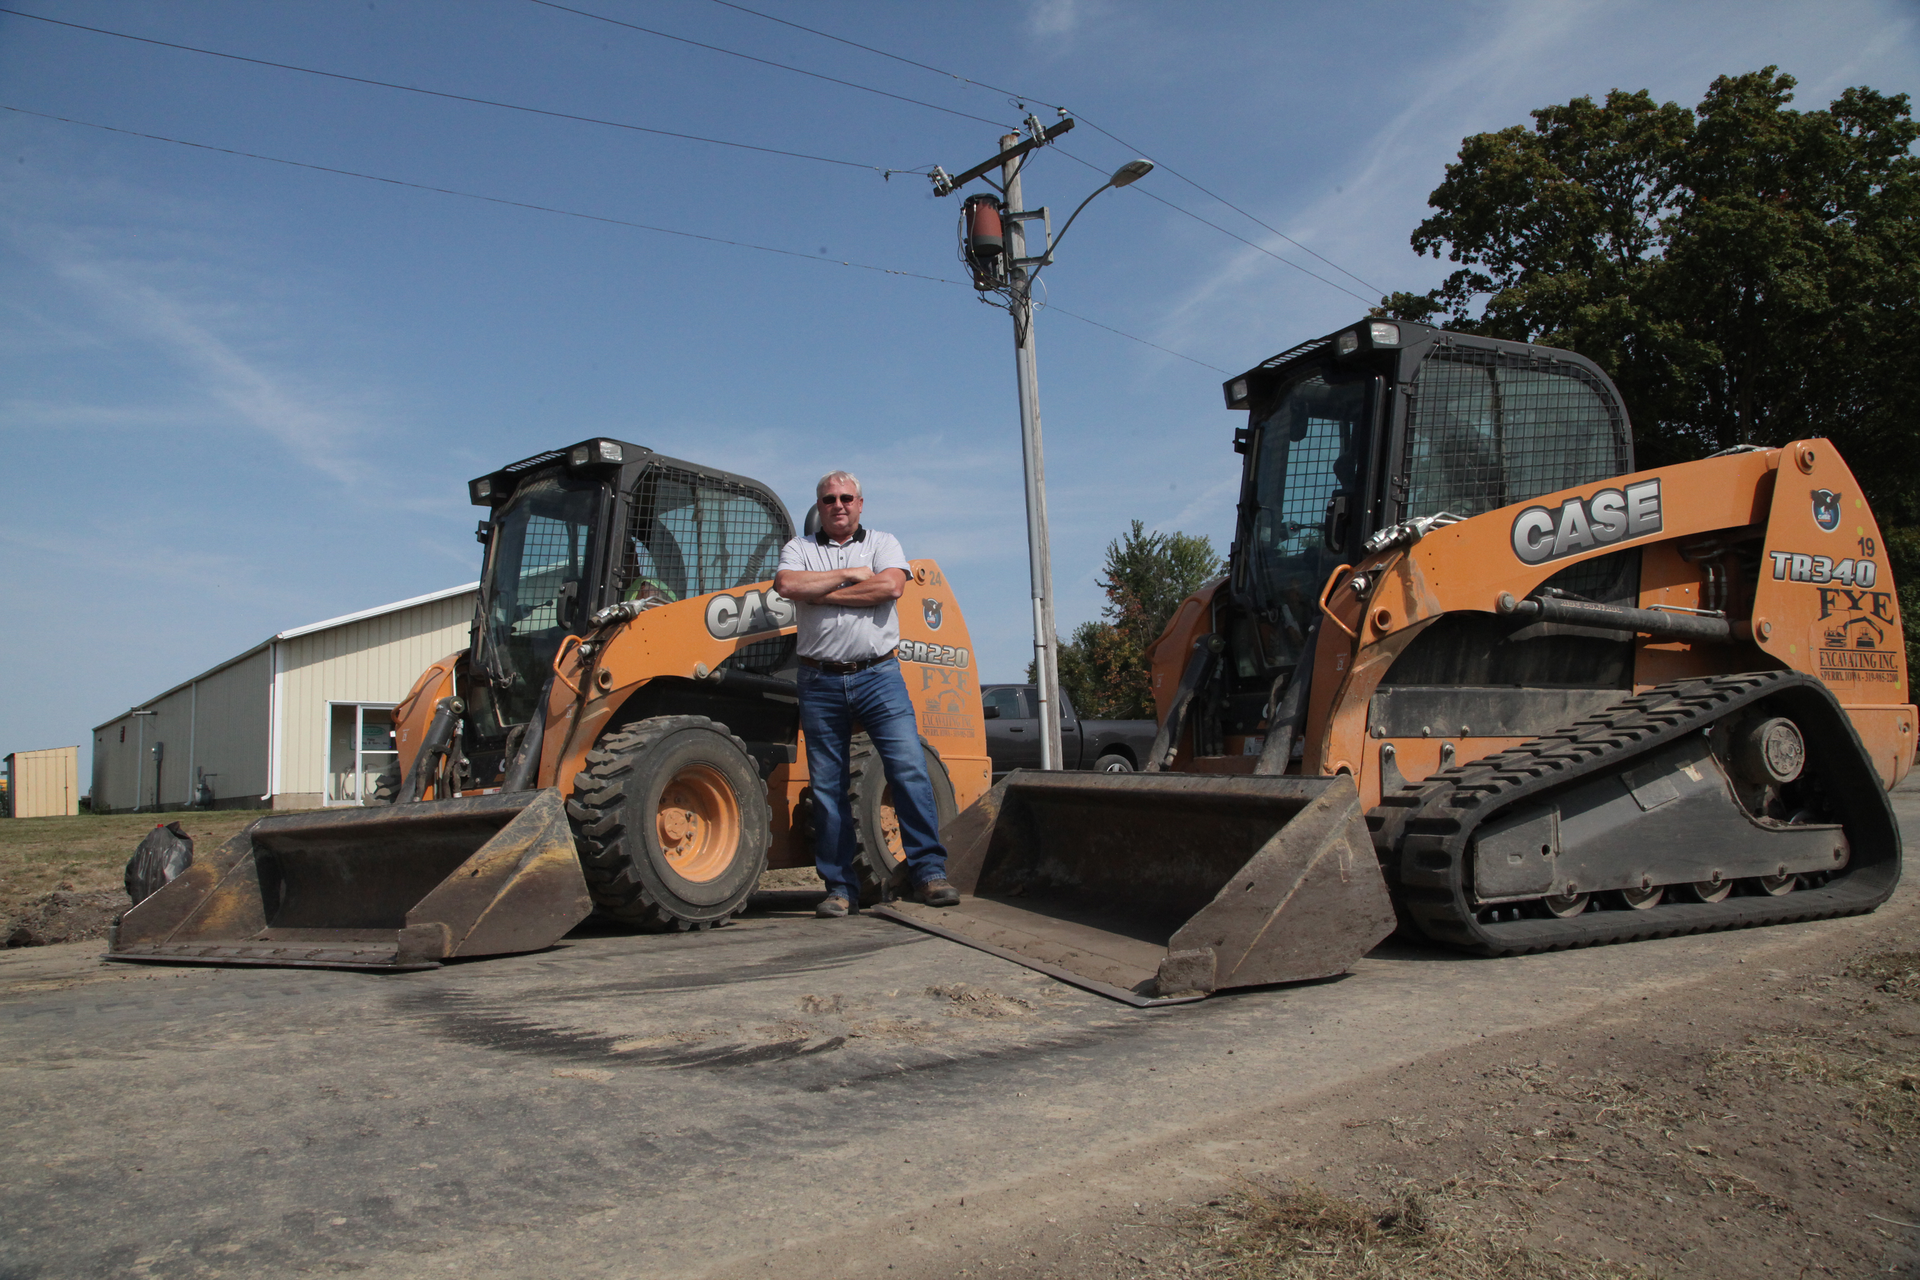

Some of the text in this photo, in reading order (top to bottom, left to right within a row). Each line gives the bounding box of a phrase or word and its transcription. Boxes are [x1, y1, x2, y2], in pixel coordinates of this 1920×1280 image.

[1511, 478, 1662, 564] CASE
[1858, 537, 1875, 557] 19
[929, 571, 942, 586] 24
[1769, 551, 1877, 588] TR340
[705, 587, 797, 638] CAS
[1816, 587, 1894, 626] FYE
[898, 639, 969, 668] SR220
[1819, 652, 1898, 669] EXCAVATING INC.
[920, 666, 972, 696] FYE
[922, 714, 960, 727] EXCAVATING
